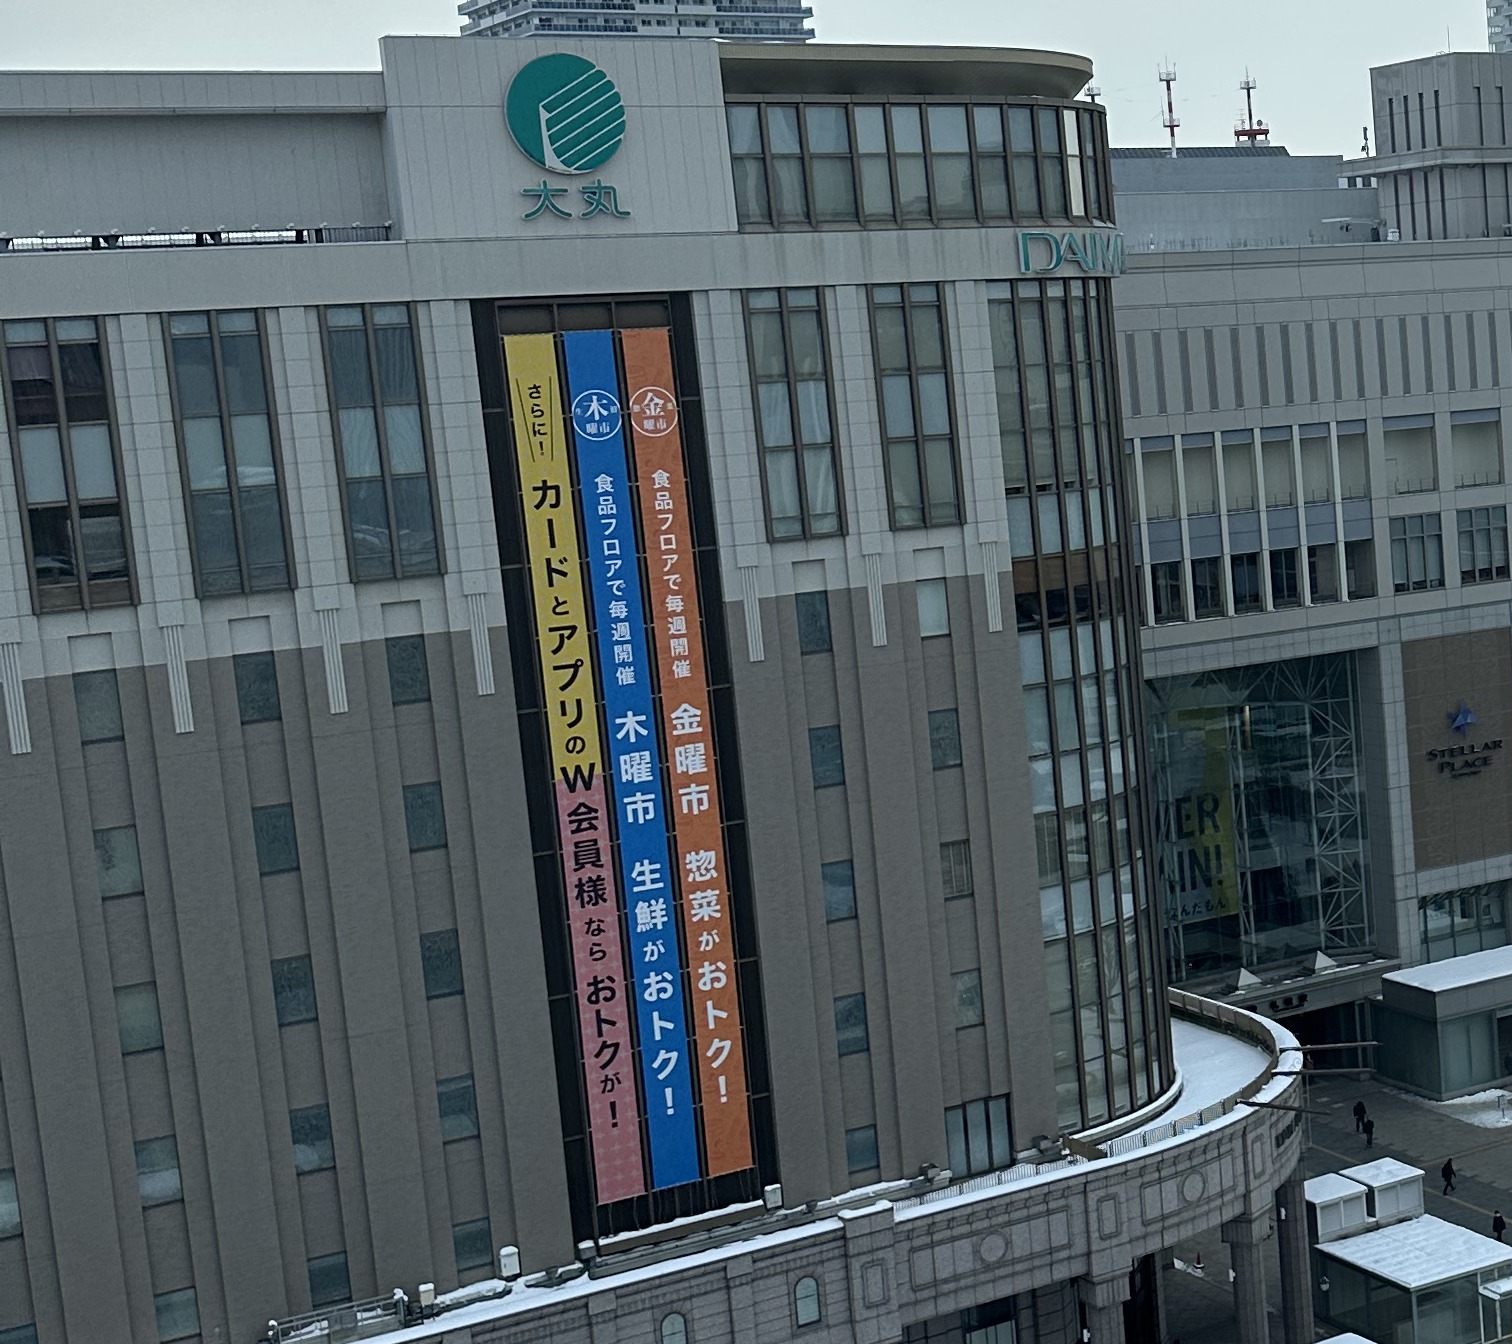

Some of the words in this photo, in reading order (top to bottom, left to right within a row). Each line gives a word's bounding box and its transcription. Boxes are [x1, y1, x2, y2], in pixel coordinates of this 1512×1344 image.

[521, 179, 632, 220] 大丸
[1017, 232, 1125, 275] DAIM
[651, 469, 692, 680] 食品フロアで毎週開催
[594, 473, 636, 686] 食品フロアで毎週開催
[615, 710, 656, 825] 木曜市
[670, 703, 711, 815] 金曜市
[1426, 739, 1503, 761] STELLAR
[1438, 755, 1494, 774] PLACE
